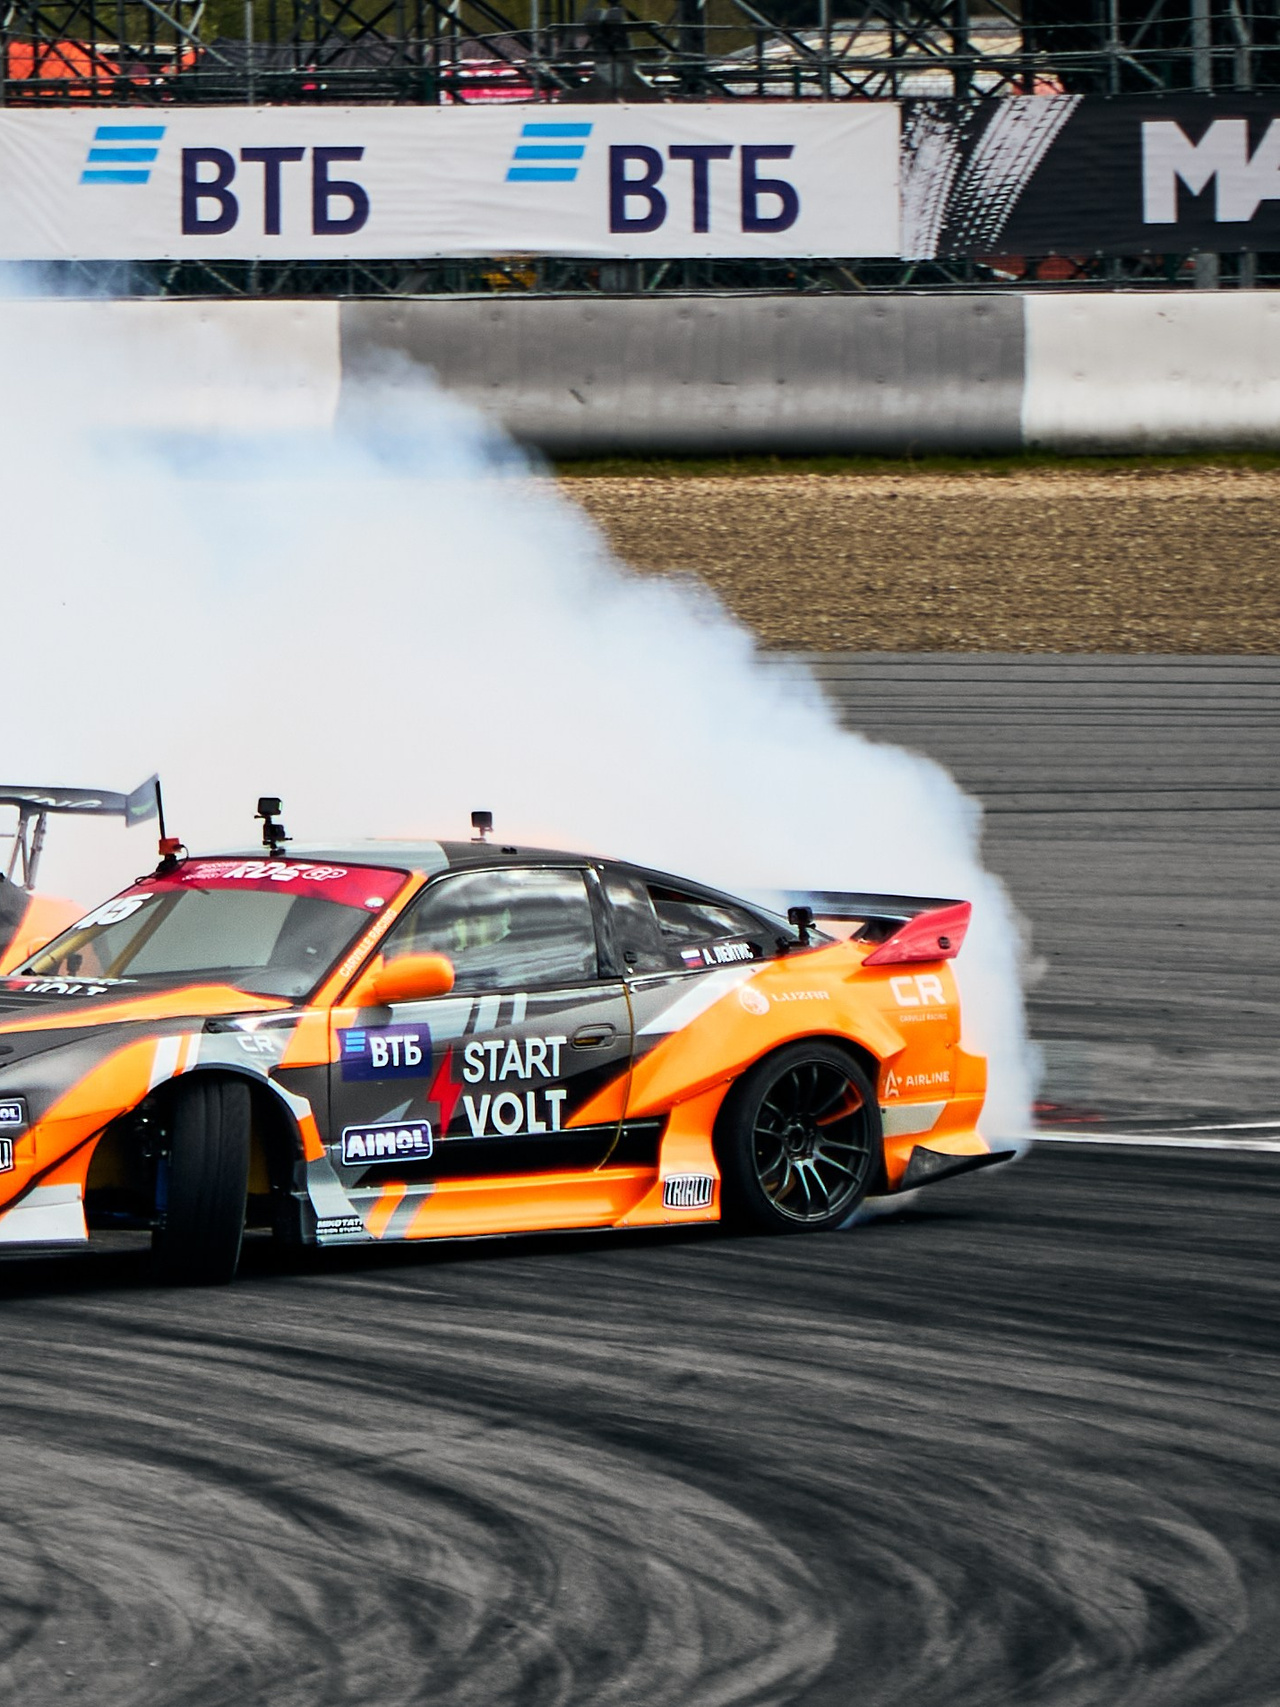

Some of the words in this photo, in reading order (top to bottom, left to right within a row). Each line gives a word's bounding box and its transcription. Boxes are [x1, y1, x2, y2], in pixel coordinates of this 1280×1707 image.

[180, 146, 371, 236] ВТБ
[608, 144, 800, 234] ВТБ
[223, 860, 317, 882] RDS
[771, 990, 830, 1002] LUZAR
[889, 974, 947, 1006] CR
[236, 1035, 276, 1052] CR
[369, 1034, 422, 1068] ВТБ
[462, 1035, 568, 1083] START
[906, 1070, 950, 1086] AIRLINE
[462, 1089, 568, 1138] VOLT
[346, 1129, 430, 1159] AIMOL
[666, 1176, 711, 1207] TRIALLI
